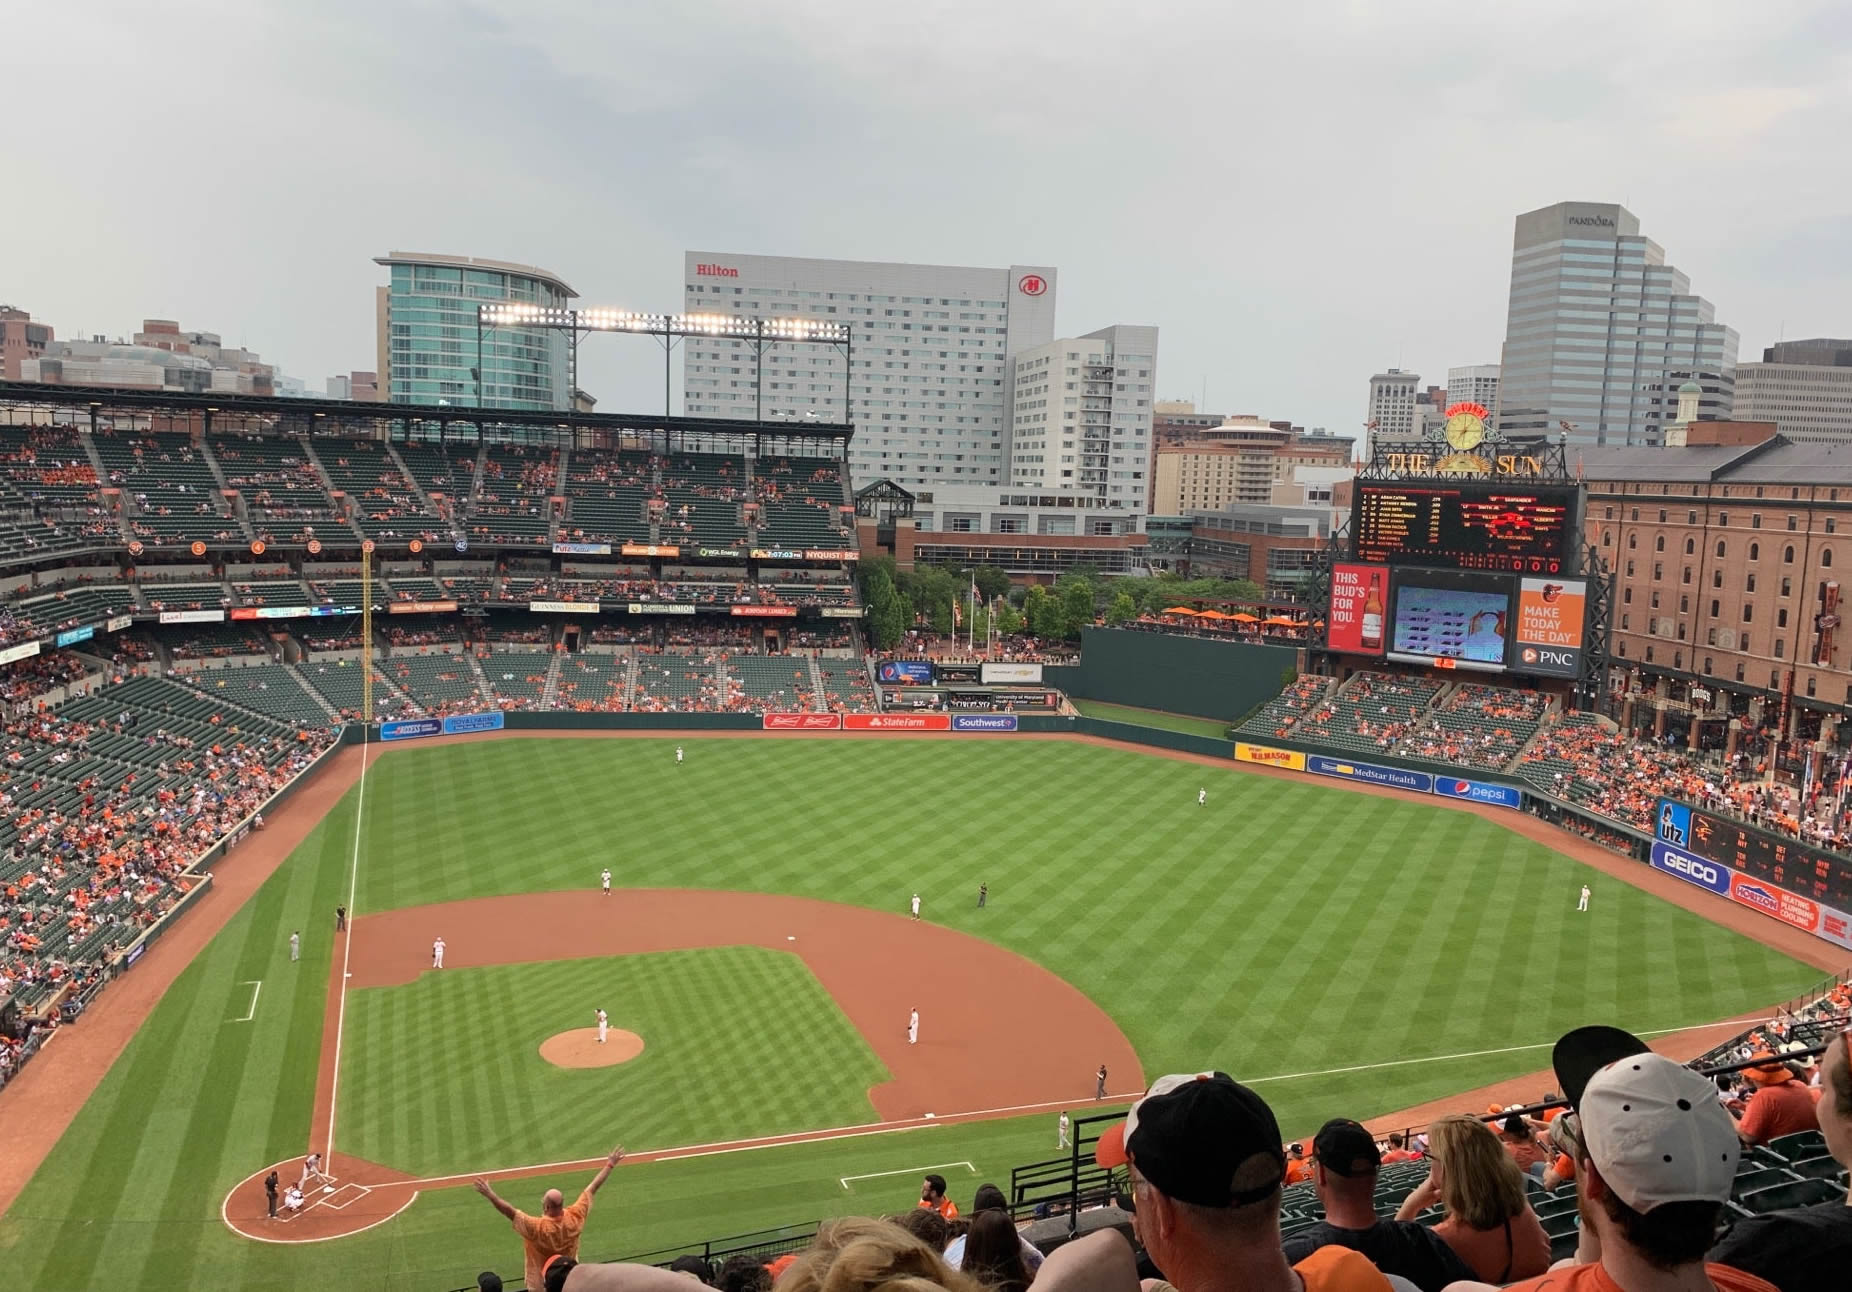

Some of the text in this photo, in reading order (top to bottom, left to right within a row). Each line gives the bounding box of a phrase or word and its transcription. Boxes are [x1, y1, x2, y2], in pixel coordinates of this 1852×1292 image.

[697, 264, 738, 278] Hilton
[1387, 454, 1542, 474] THE SUN
[720, 549, 739, 557] Energy
[1513, 560, 1558, 573] 0 0 0
[1335, 572, 1358, 584] THIS
[1334, 585, 1365, 598] BUD'S
[669, 605, 695, 613] UNION
[1333, 598, 1353, 609] FOR
[1332, 610, 1355, 623] YOU.
[1524, 605, 1560, 618] MAKE
[1523, 617, 1561, 631] TODAY
[1522, 629, 1572, 643] THE DAY
[1539, 650, 1573, 666] PNC
[959, 718, 1005, 727] Southwest
[1354, 767, 1416, 785] MedStar Health
[1472, 786, 1505, 800] pepsi
[1664, 851, 1717, 884] GEICO
[1736, 886, 1778, 911] HORIZON
[1781, 893, 1810, 911] HEATING
[1780, 901, 1815, 920] PLUMBING
[1780, 909, 1809, 927] COOLING
